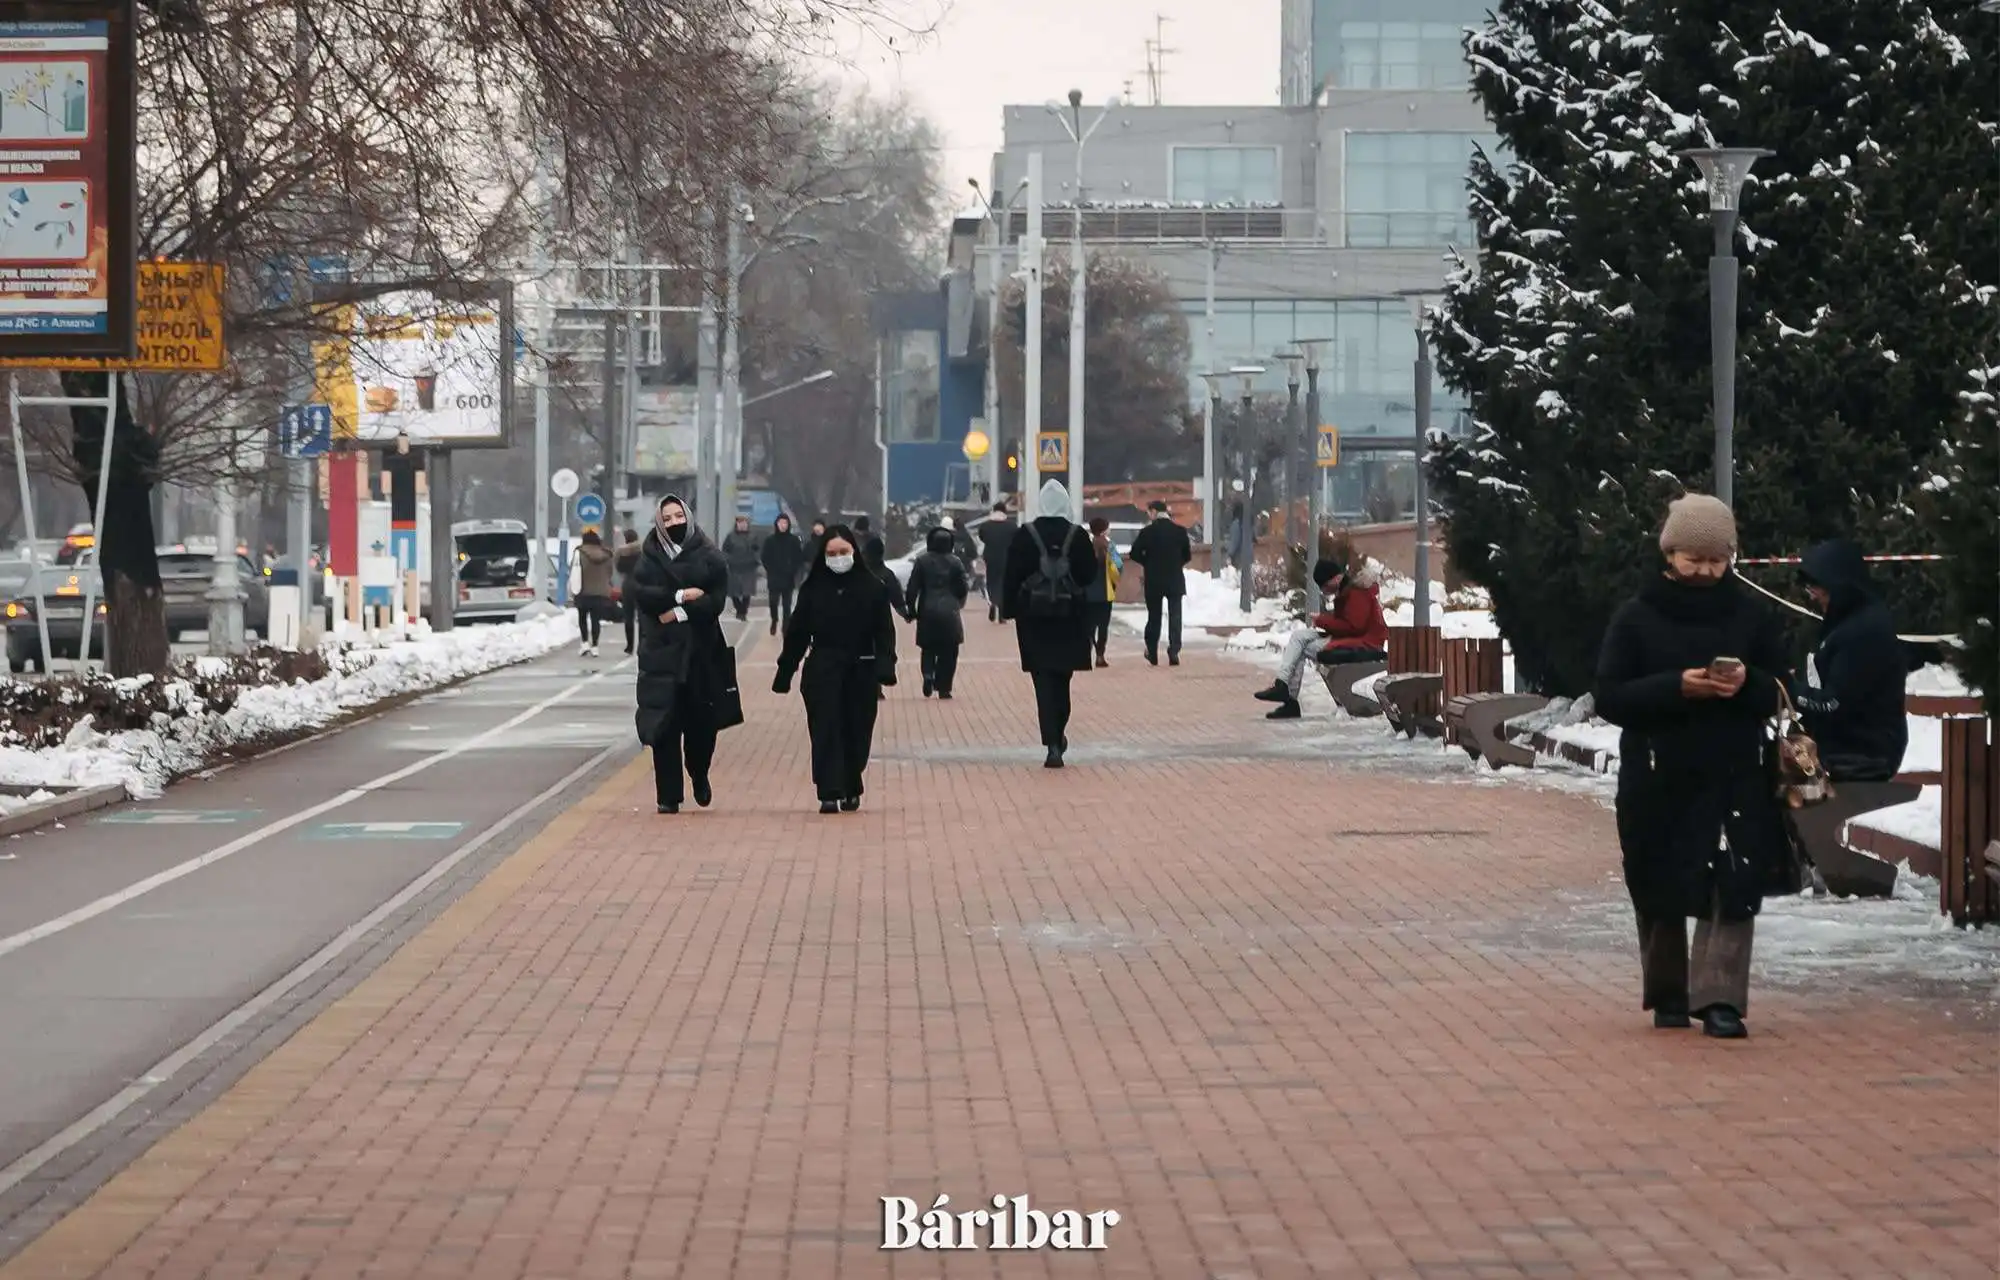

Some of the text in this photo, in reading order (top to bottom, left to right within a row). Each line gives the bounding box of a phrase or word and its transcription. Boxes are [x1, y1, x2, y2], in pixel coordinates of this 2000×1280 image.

[15, 317, 39, 330] ДЧС
[51, 318, 95, 328] Алматы
[456, 394, 492, 409] 600
